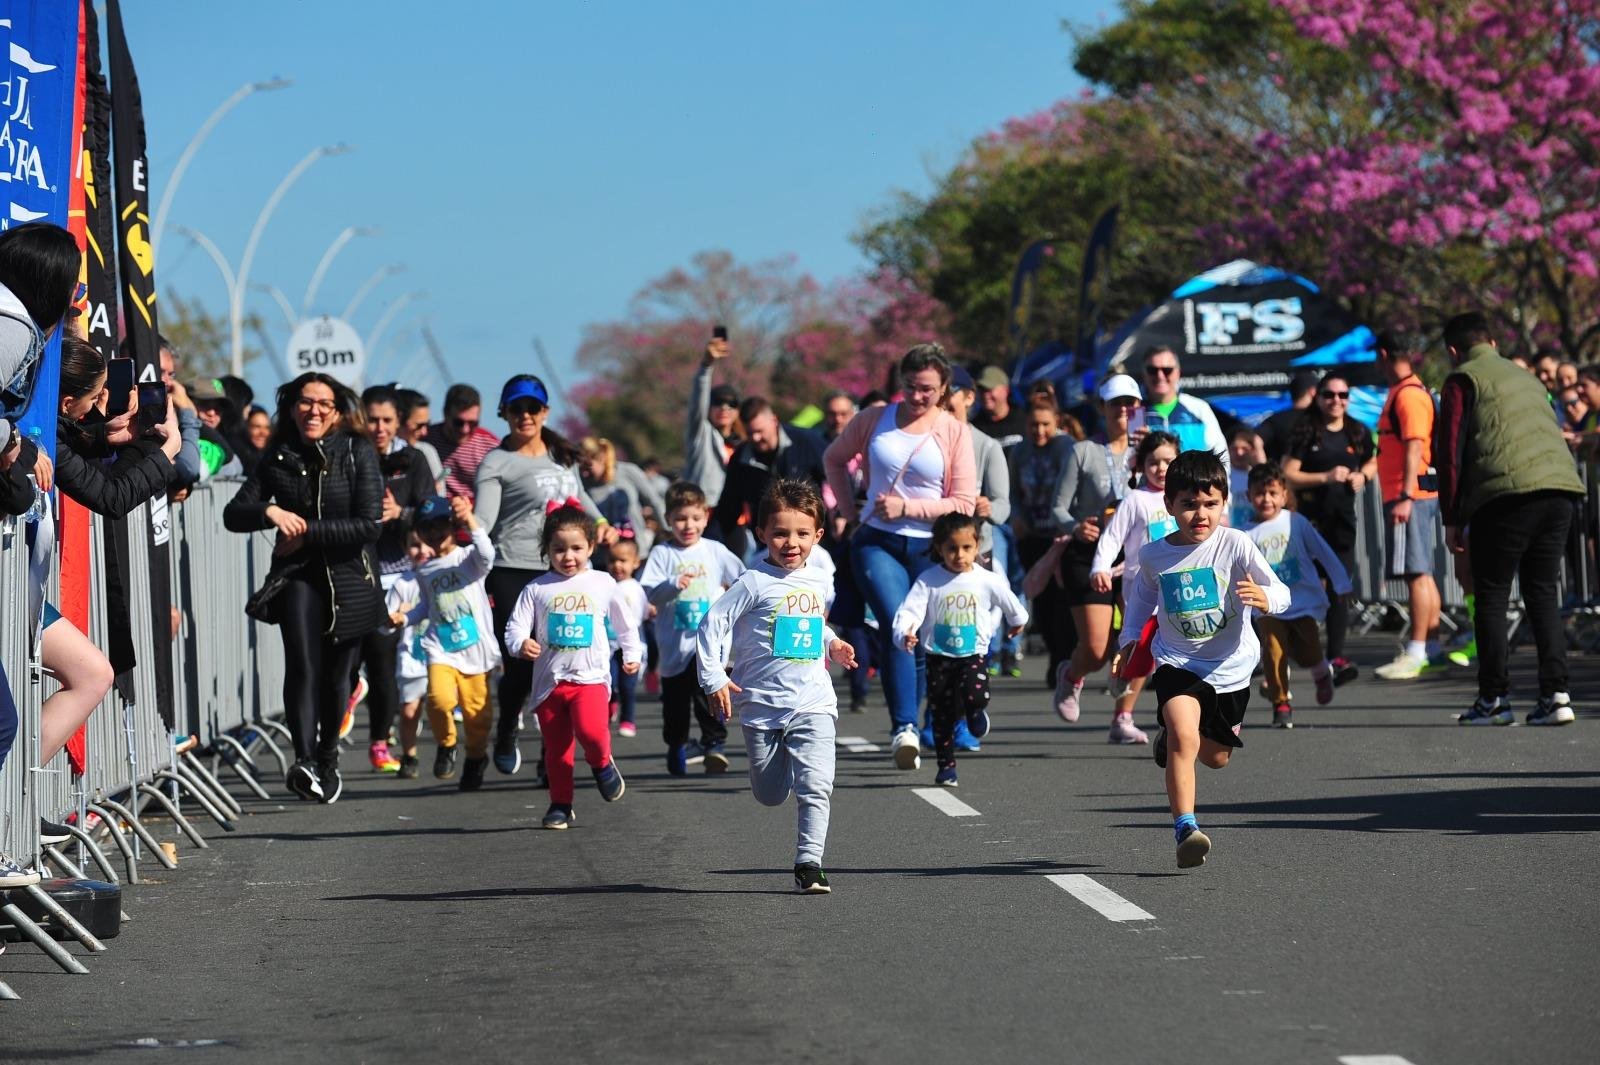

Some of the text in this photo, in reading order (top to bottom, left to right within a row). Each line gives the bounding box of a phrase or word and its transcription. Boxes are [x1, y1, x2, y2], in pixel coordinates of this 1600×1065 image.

[1196, 296, 1305, 344] FS
[298, 348, 355, 369] 50m
[1173, 584, 1207, 602] 104
[553, 595, 587, 612] POA
[787, 592, 820, 615] POA
[945, 594, 976, 610] POA
[556, 624, 584, 638] 162
[1180, 608, 1227, 638] RUN
[451, 629, 469, 643] 63
[792, 632, 812, 648] 75
